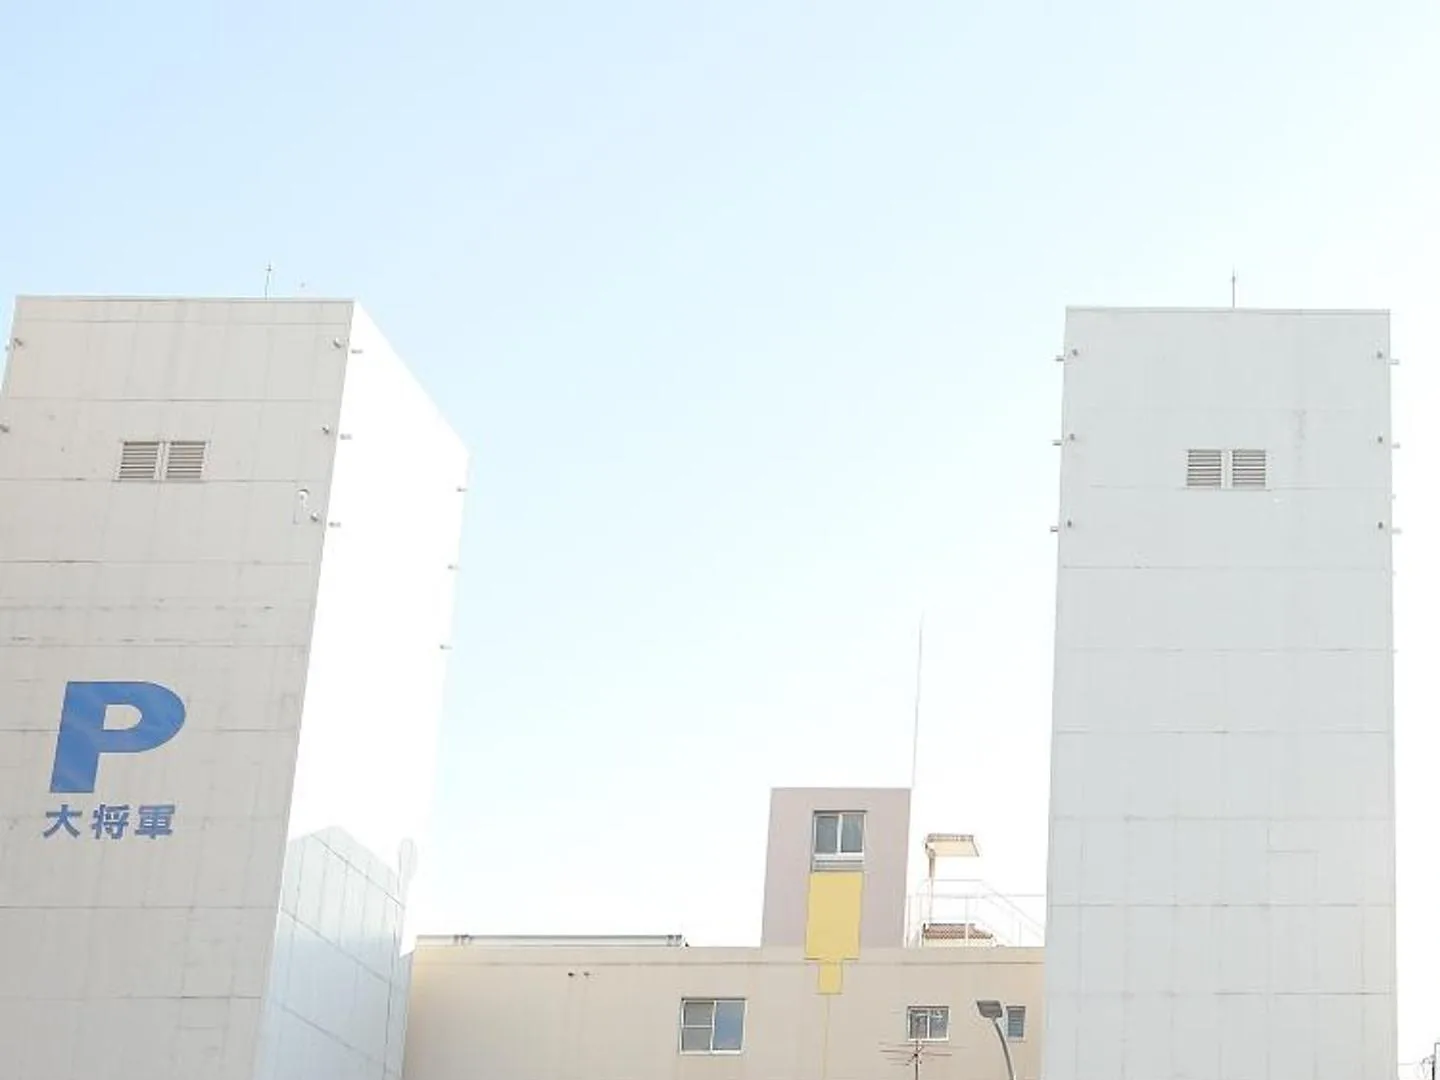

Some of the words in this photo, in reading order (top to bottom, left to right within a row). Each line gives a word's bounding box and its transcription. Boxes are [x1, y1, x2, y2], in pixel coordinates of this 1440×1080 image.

[50, 681, 186, 793] P
[43, 804, 176, 839] 大将軍
